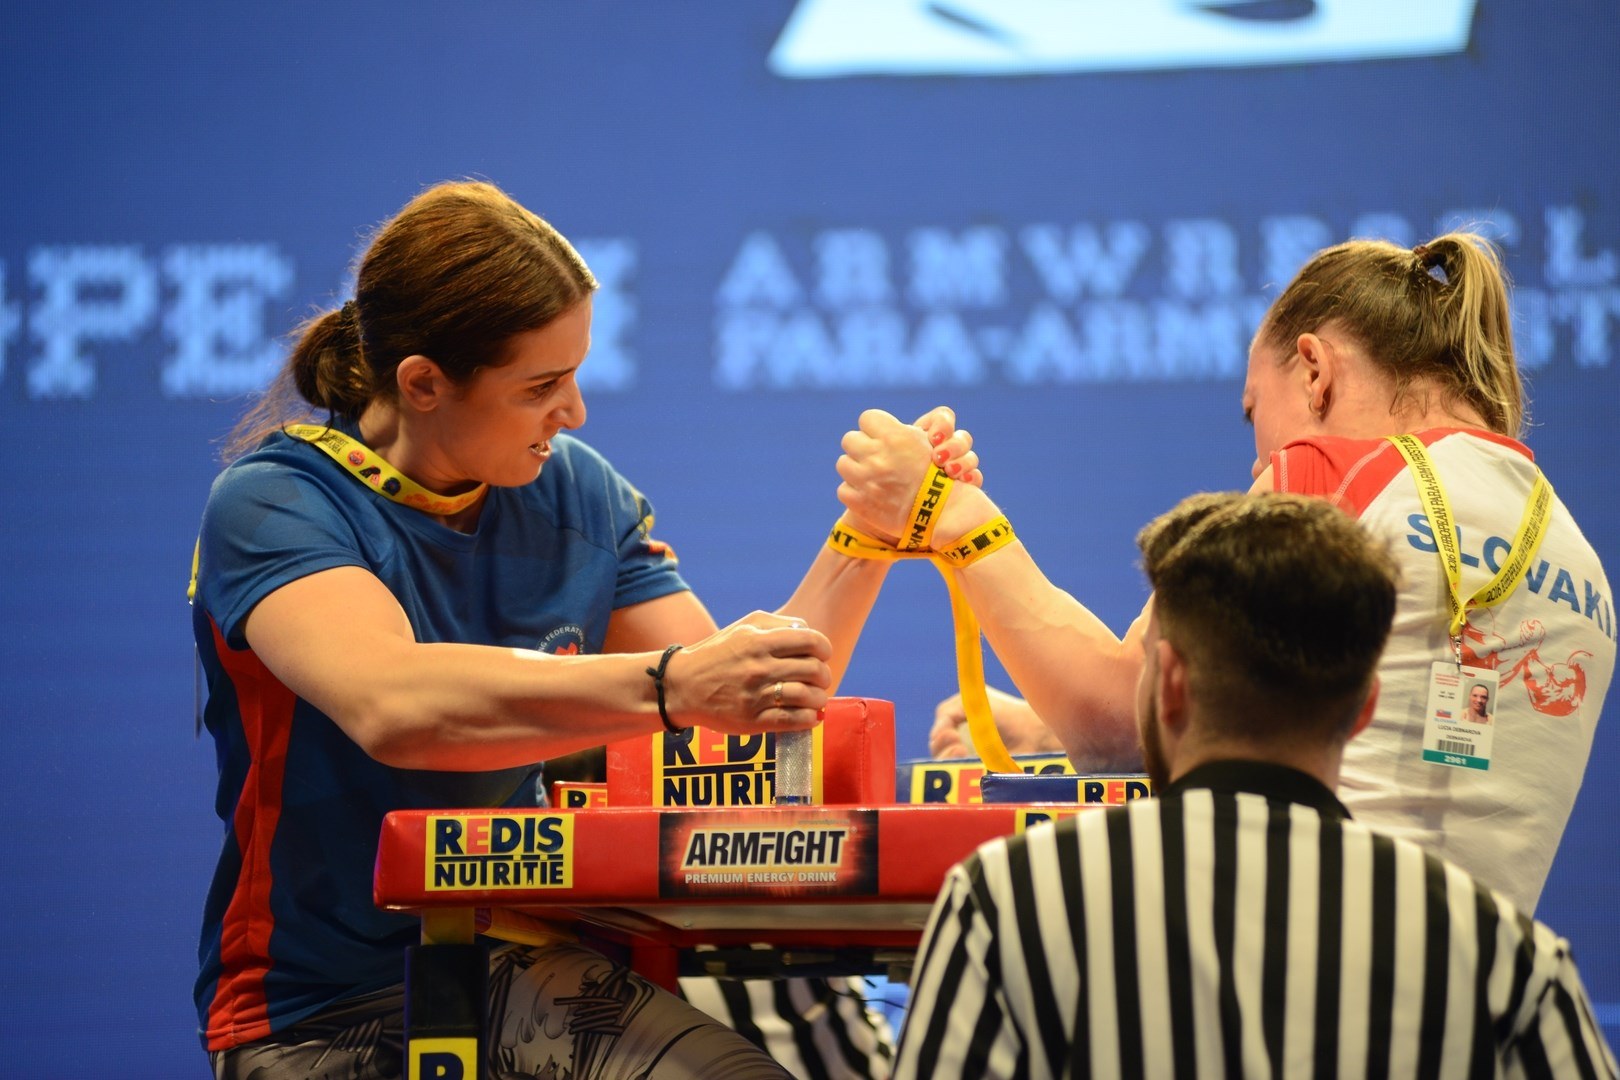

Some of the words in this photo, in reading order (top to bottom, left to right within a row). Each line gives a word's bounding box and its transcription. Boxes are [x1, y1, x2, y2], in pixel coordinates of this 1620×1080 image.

[0, 244, 296, 397] PE
[1433, 508, 1455, 553] EUROPEAN
[1407, 514, 1615, 641] SLOVAKI
[663, 726, 776, 766] REDI
[663, 773, 776, 806] NUTRIT
[1085, 782, 1149, 804] RED
[435, 817, 564, 855] REDIS
[685, 830, 845, 866] ARMFIGHT
[434, 859, 563, 887] NUTRITIE
[685, 873, 743, 884] PREMIUM
[747, 872, 795, 883] ENERGY
[798, 871, 836, 882] DRINK
